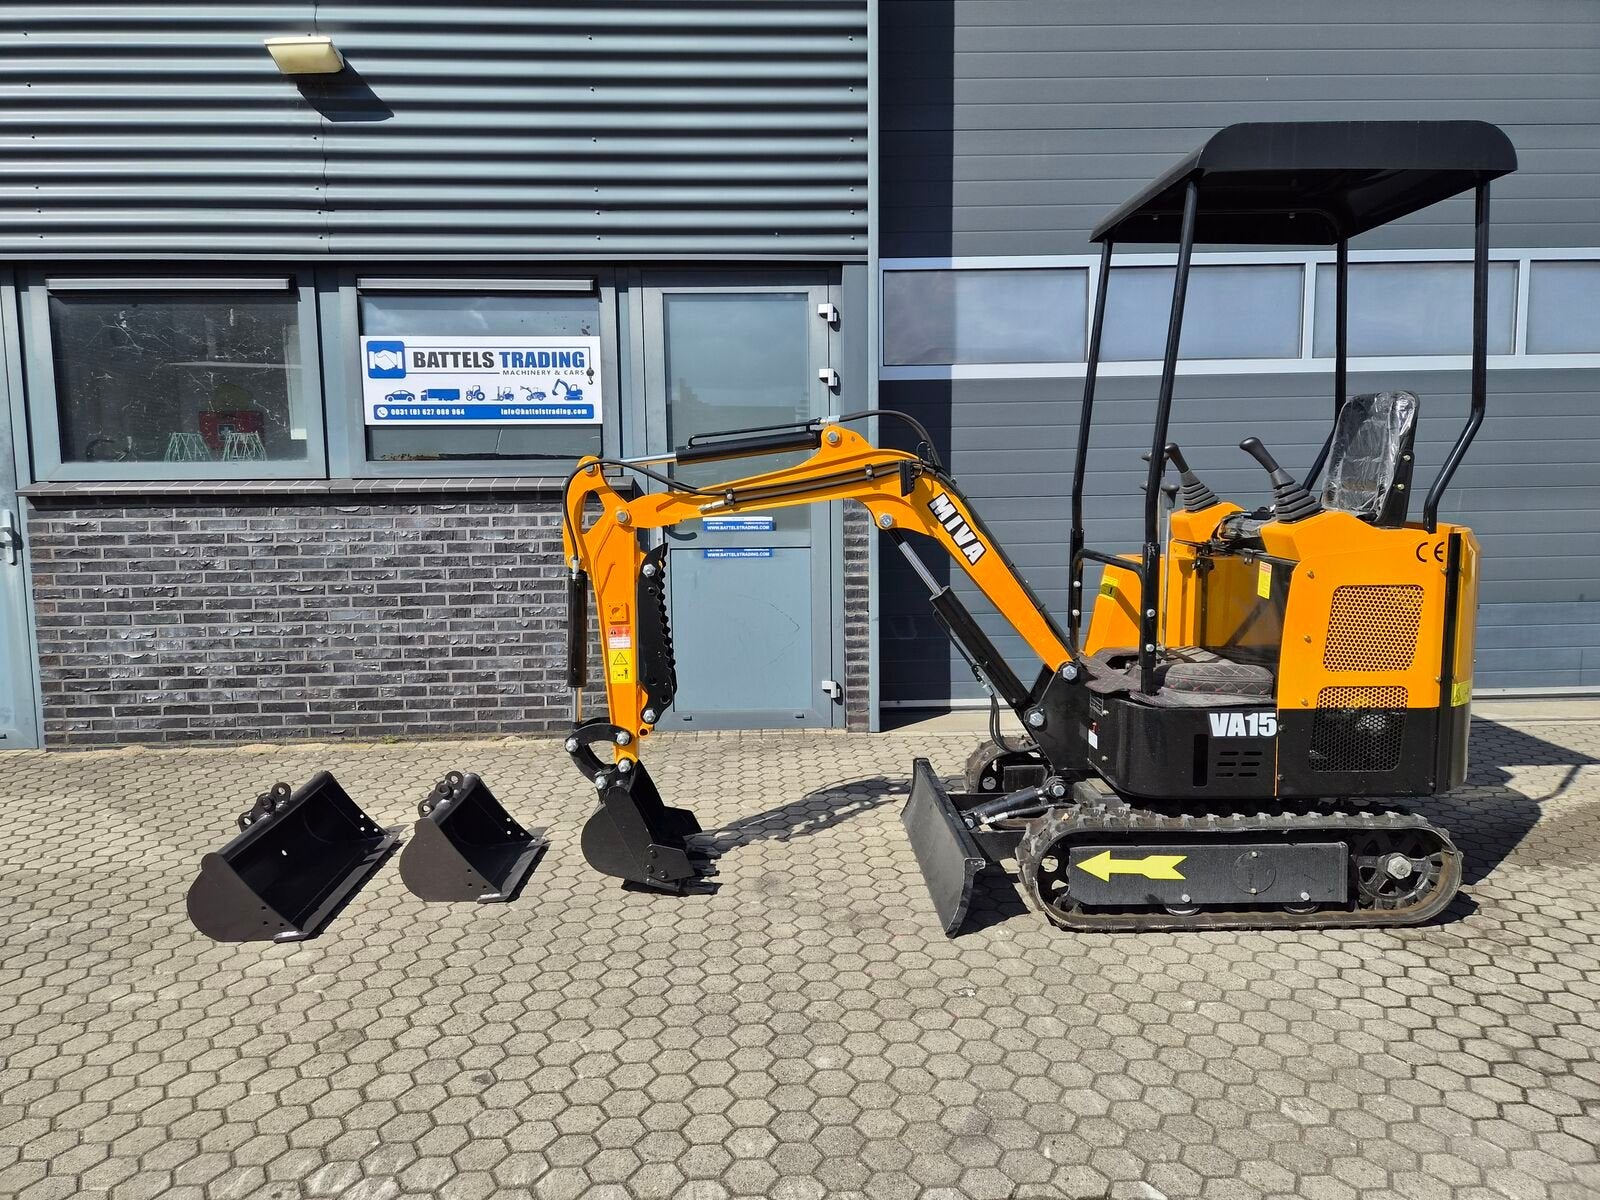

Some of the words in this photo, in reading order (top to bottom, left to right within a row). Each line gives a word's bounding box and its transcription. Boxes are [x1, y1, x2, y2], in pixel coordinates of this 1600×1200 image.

[413, 351, 495, 369] BATTELS
[499, 351, 585, 369] TRADING
[390, 408, 408, 416] 0031
[928, 492, 986, 565] MIVA
[1209, 712, 1277, 737] VA15
